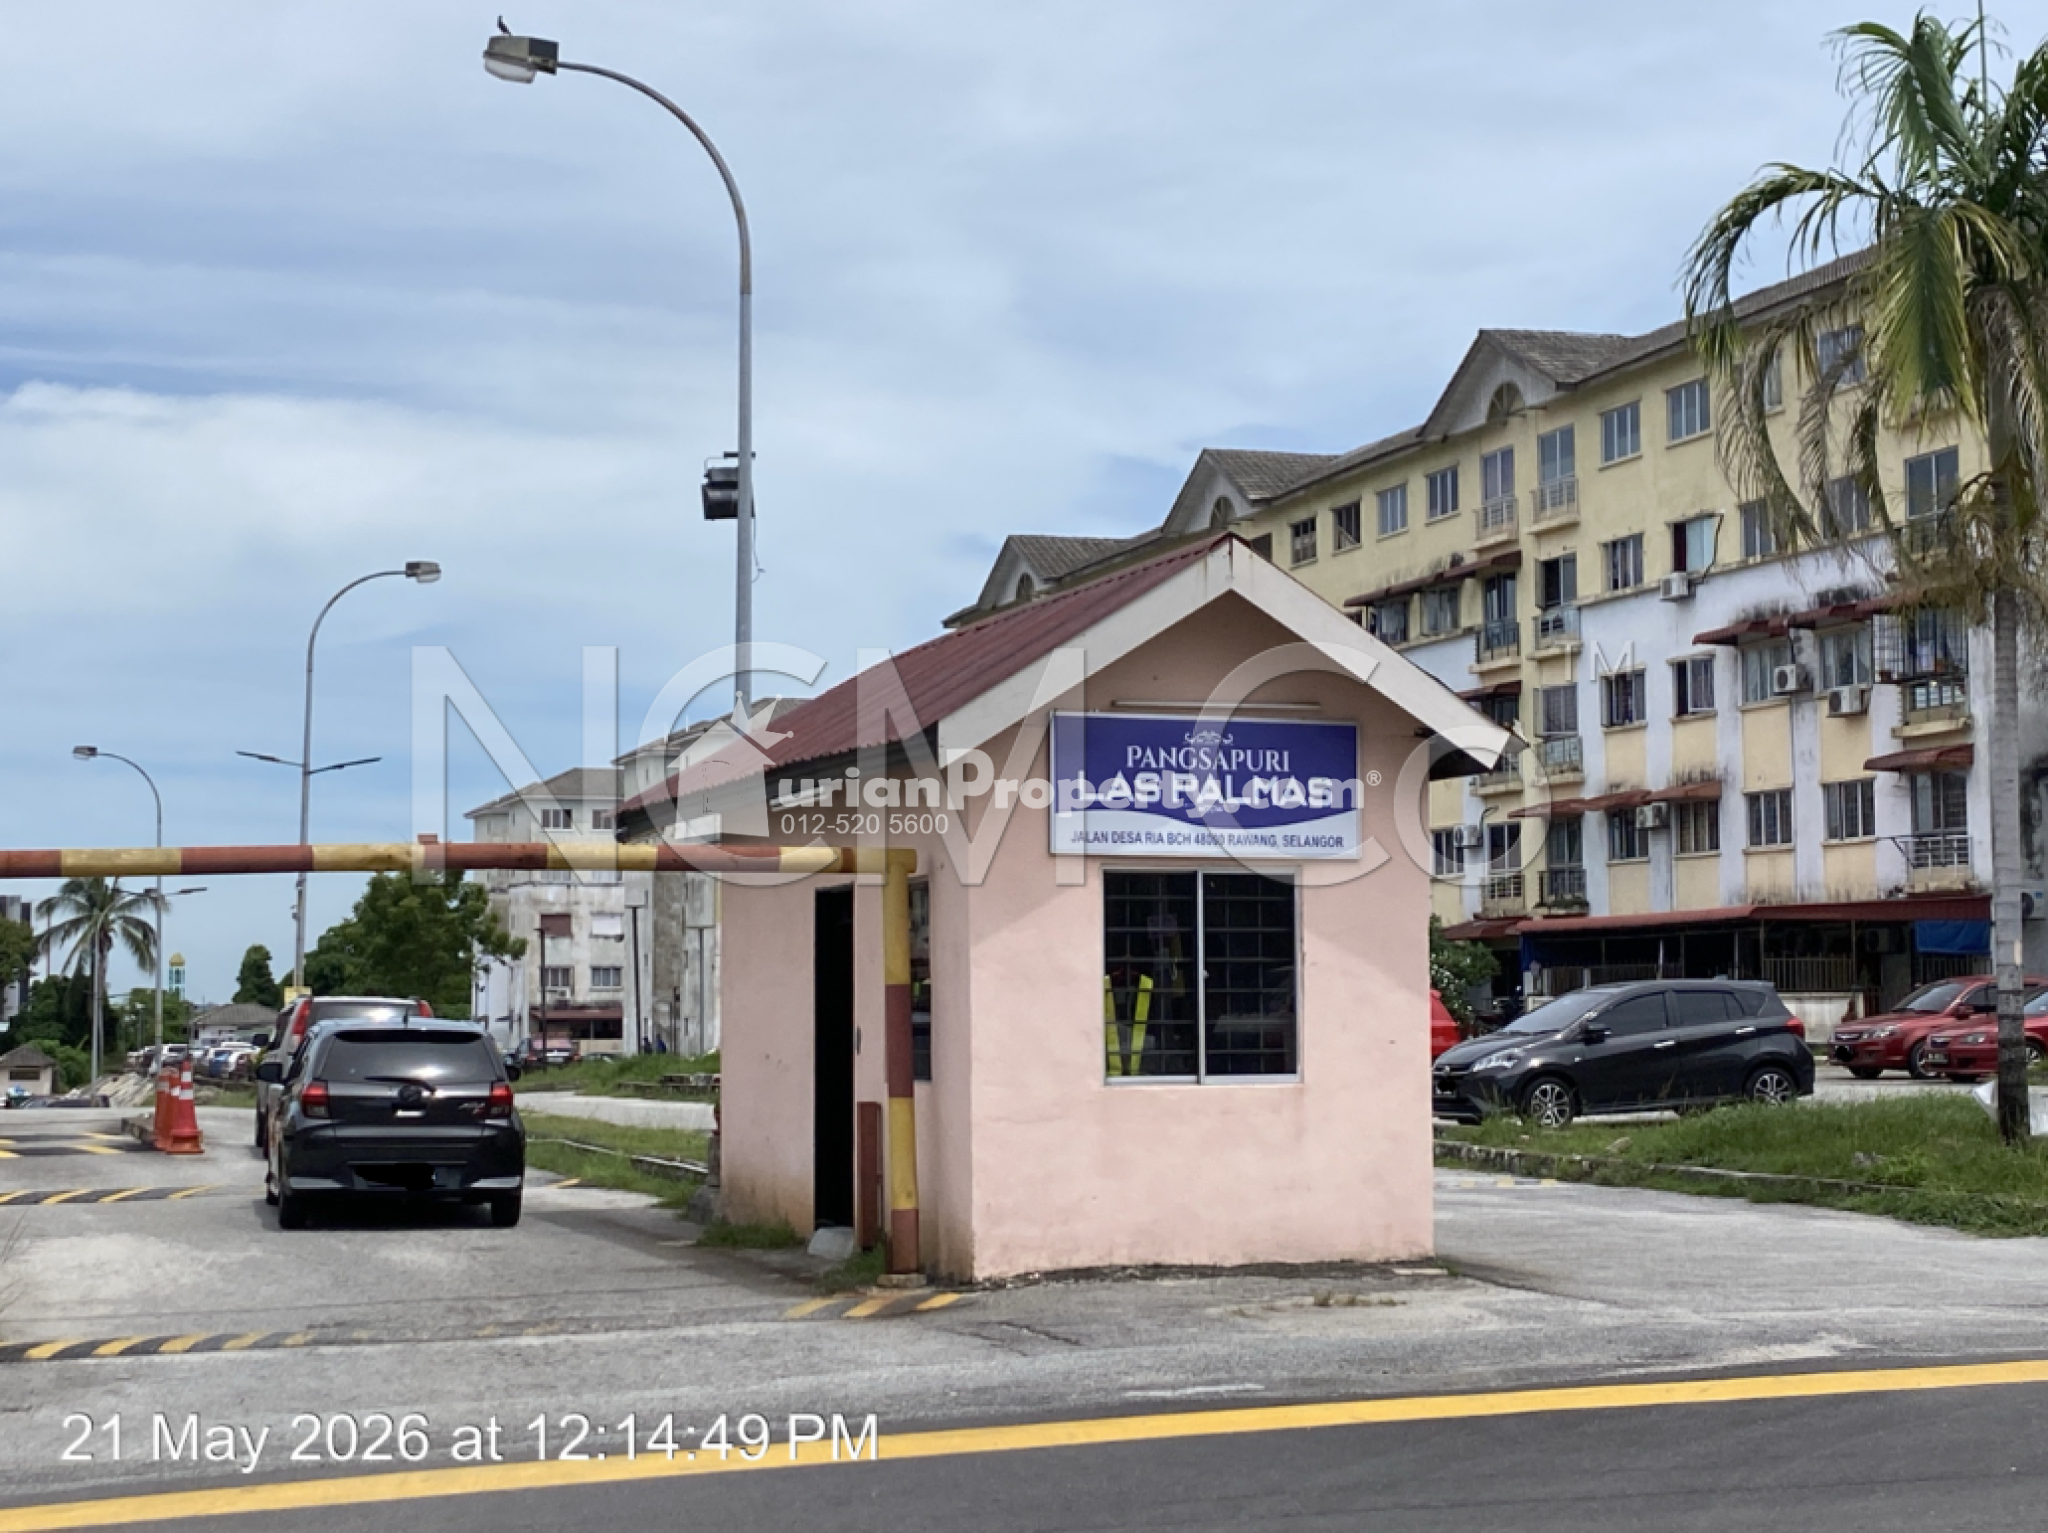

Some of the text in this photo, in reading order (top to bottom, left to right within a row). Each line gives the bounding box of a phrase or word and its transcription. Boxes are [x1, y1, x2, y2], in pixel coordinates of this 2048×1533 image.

[1126, 745, 1290, 772] PANGSAPURI
[1077, 769, 1333, 807] LAS PALMAS
[1071, 830, 1109, 844] JALAN
[1111, 830, 1143, 845] DESA
[1144, 832, 1165, 845] RIA
[1281, 834, 1344, 848] SELANGOR
